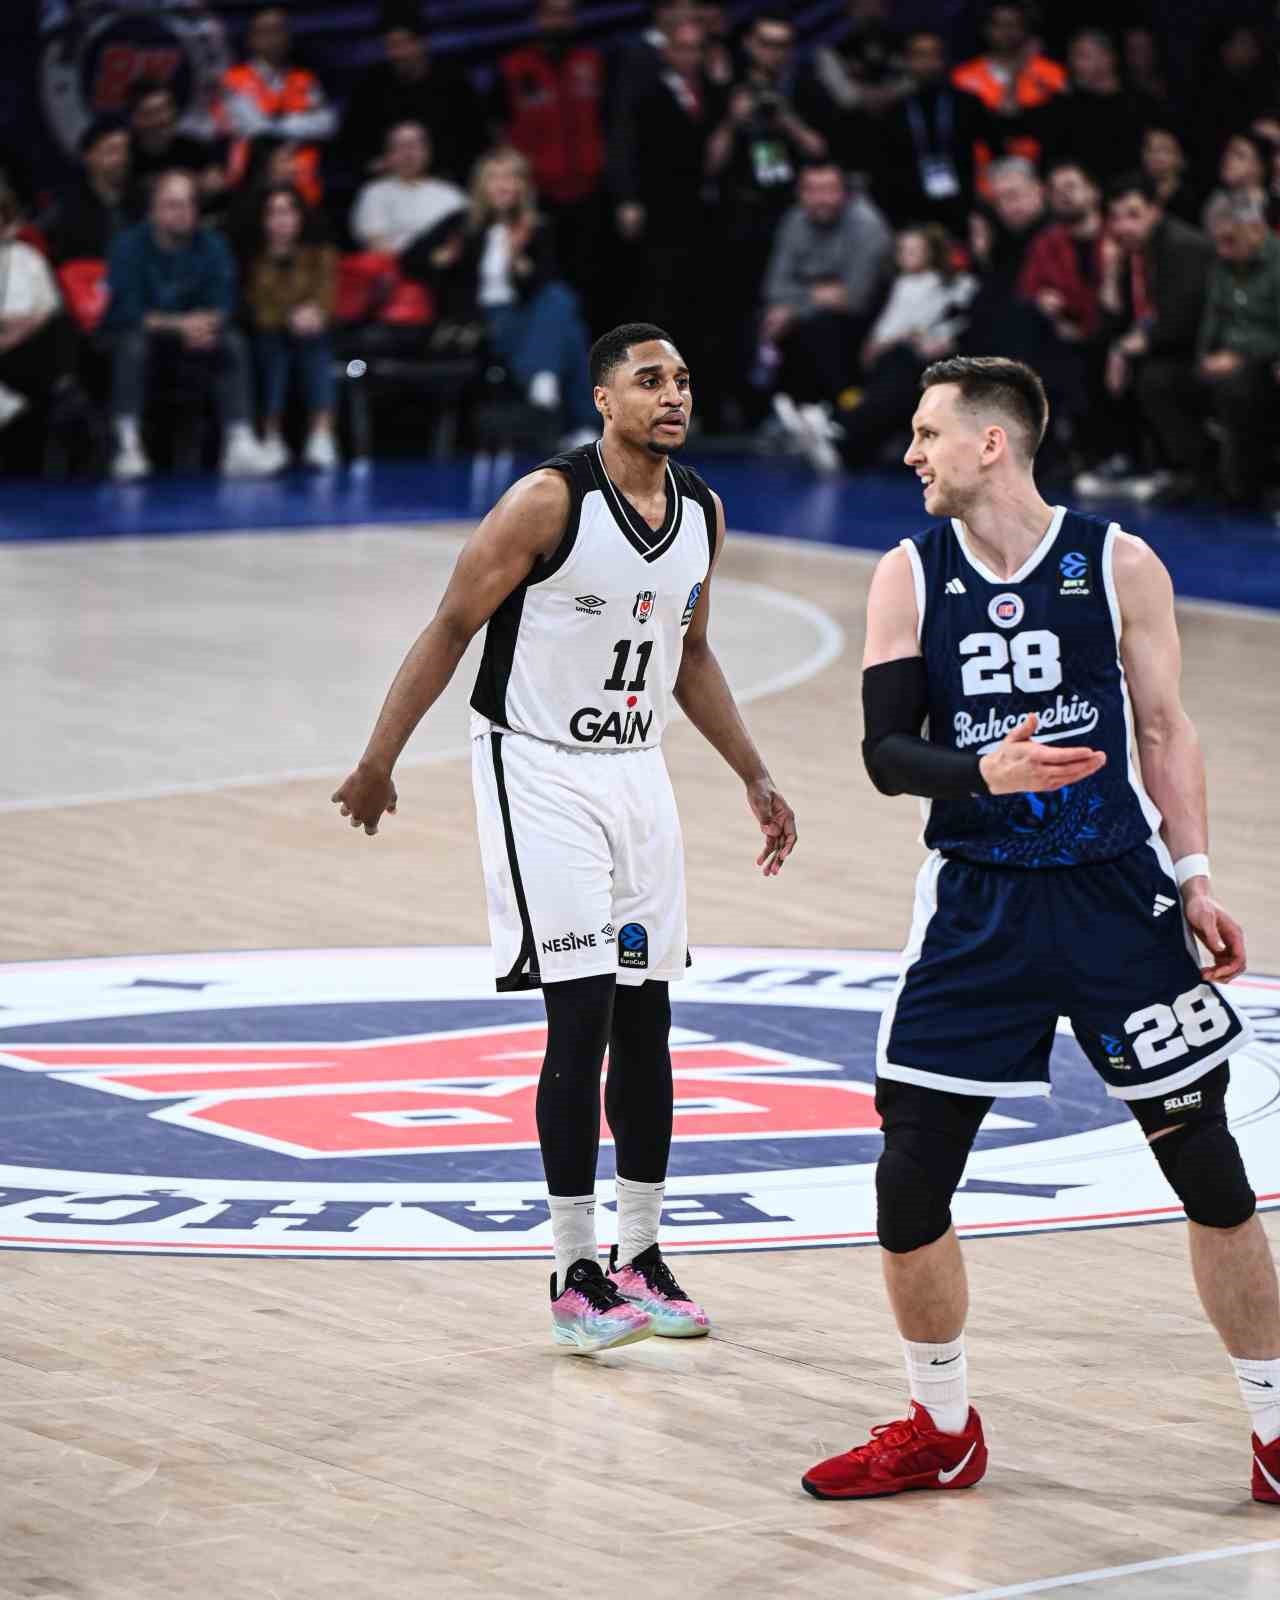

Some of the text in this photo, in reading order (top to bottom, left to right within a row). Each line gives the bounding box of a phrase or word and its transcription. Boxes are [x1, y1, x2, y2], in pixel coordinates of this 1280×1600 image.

[575, 605, 602, 616] umbro
[603, 639, 655, 692] 11
[959, 630, 1063, 696] 28
[1124, 983, 1231, 1069] 28
[1164, 1091, 1202, 1110] SELECT
